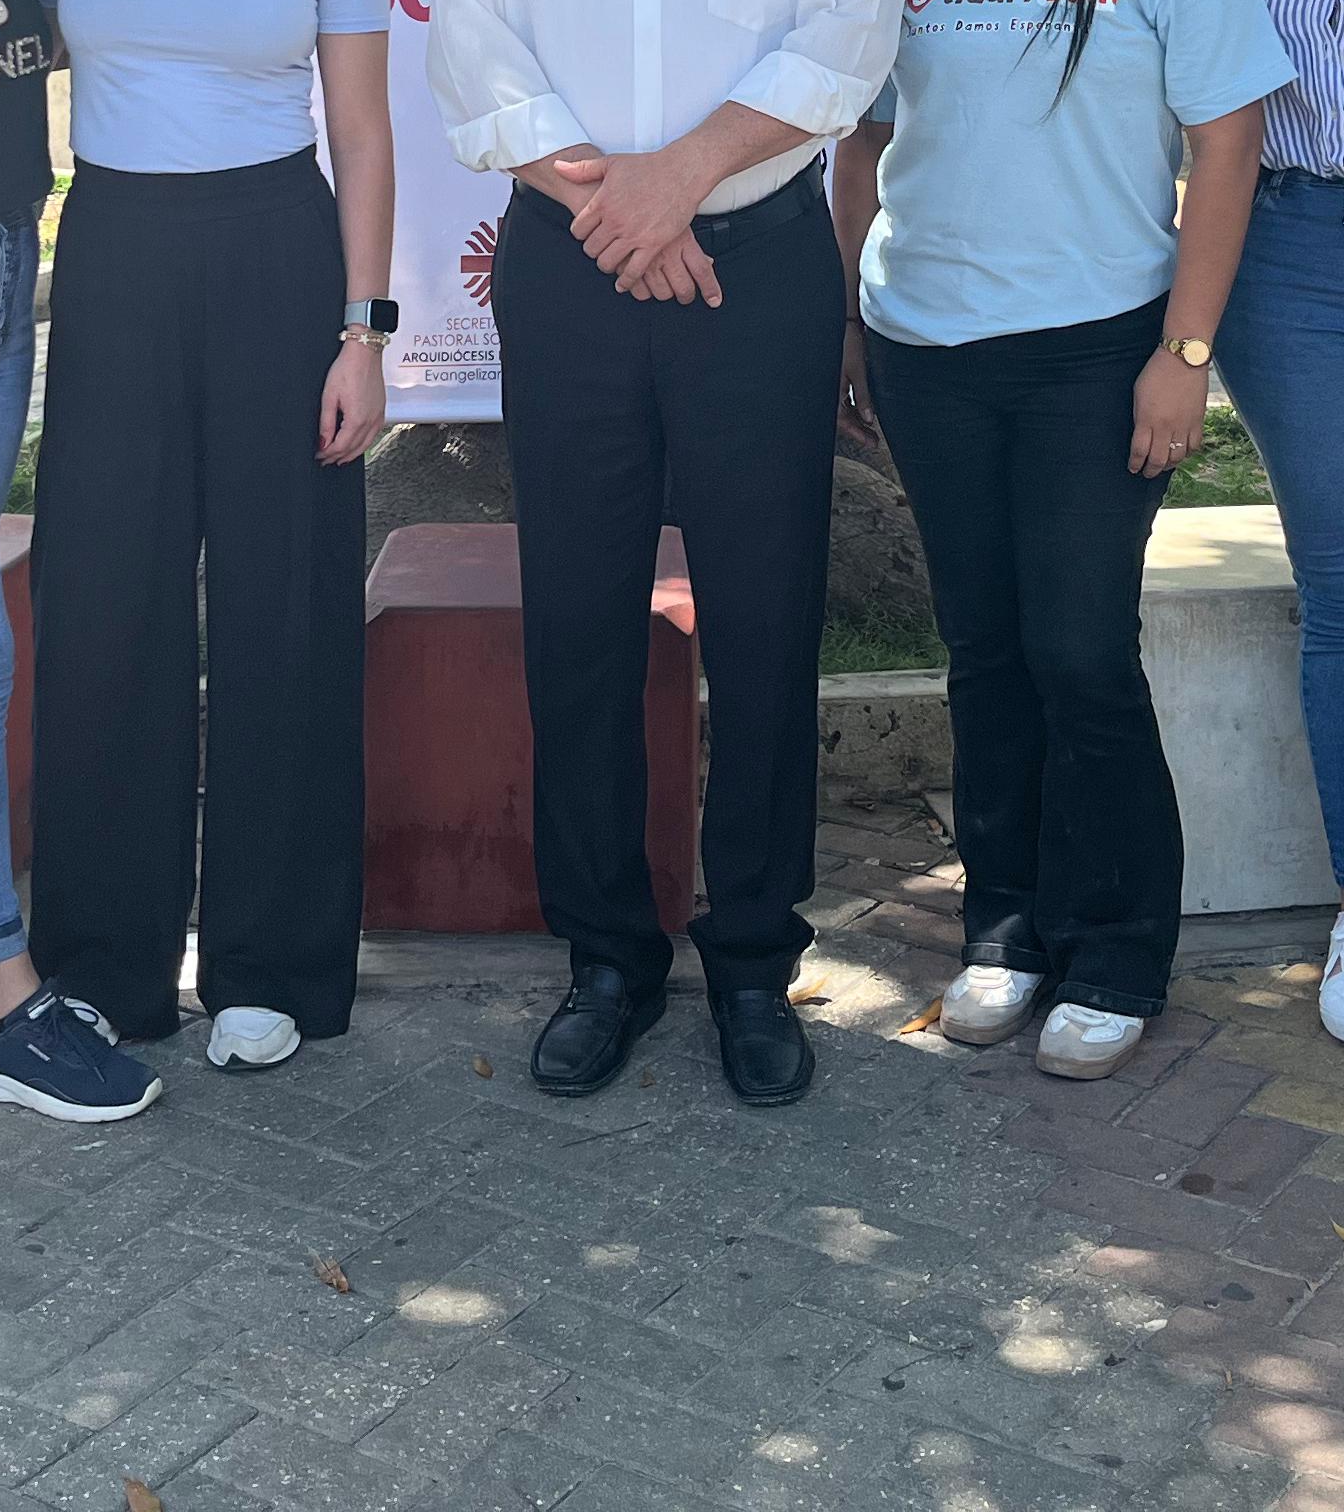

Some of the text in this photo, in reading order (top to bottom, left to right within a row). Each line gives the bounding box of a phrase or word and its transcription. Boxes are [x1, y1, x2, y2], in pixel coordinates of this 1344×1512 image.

[907, 17, 1072, 38] Juntos Damos Esperan
[414, 332, 501, 348] PASTORAL SO
[402, 348, 495, 364] ARQUIDIÓCESIS
